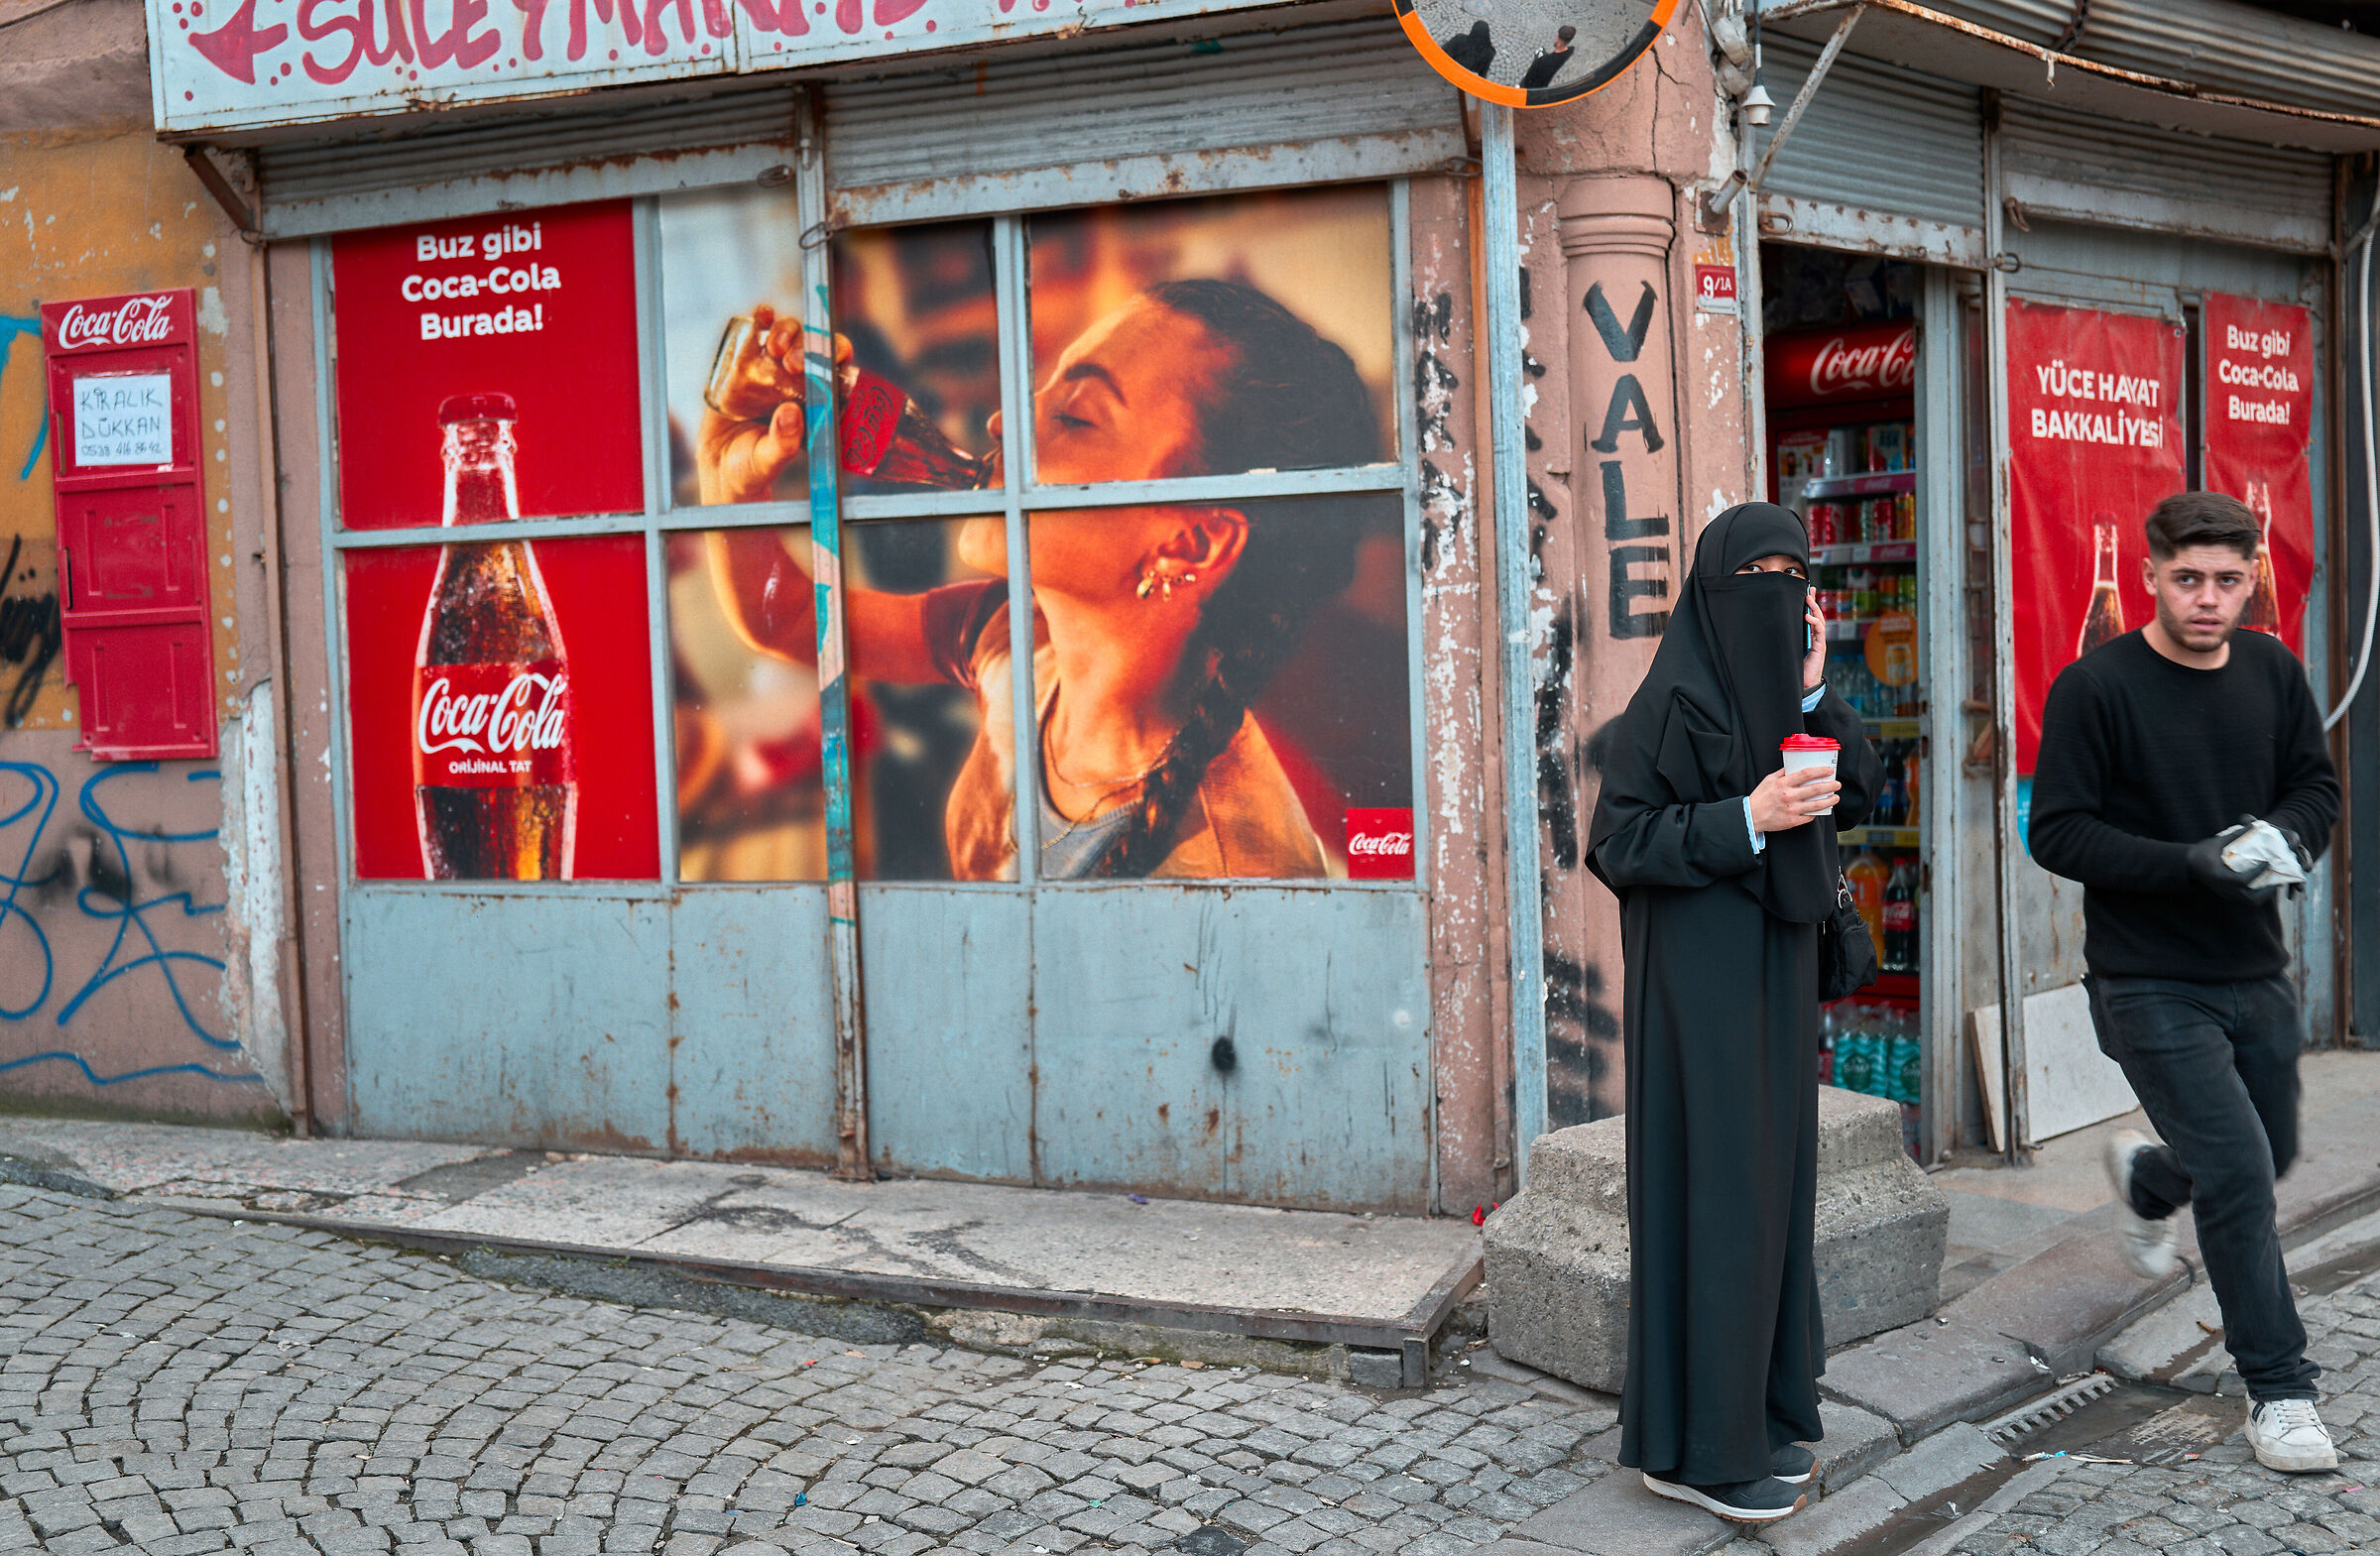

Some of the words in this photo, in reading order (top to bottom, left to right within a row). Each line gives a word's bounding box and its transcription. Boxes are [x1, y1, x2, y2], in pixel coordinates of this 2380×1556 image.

[416, 234, 475, 262] Buz
[482, 221, 542, 261] gibi
[402, 262, 561, 302] Coca-Cola
[58, 295, 174, 350] Coca-Cola
[420, 302, 543, 341] Burada!
[2227, 324, 2259, 352] Buz
[2261, 328, 2291, 359] gibi
[1810, 328, 1914, 395] Coca-Co
[2218, 358, 2300, 392] Coca-Cola
[2036, 358, 2095, 401] YÜCE
[2098, 373, 2160, 408] HAYAT
[2031, 408, 2164, 449] BAKKALİYESİ
[2228, 395, 2291, 425] Burada!
[1583, 279, 1670, 640] VALE
[418, 672, 567, 754] Coca-Cola
[509, 760, 533, 773] TAT
[1349, 831, 1412, 855] Coca-Cola
